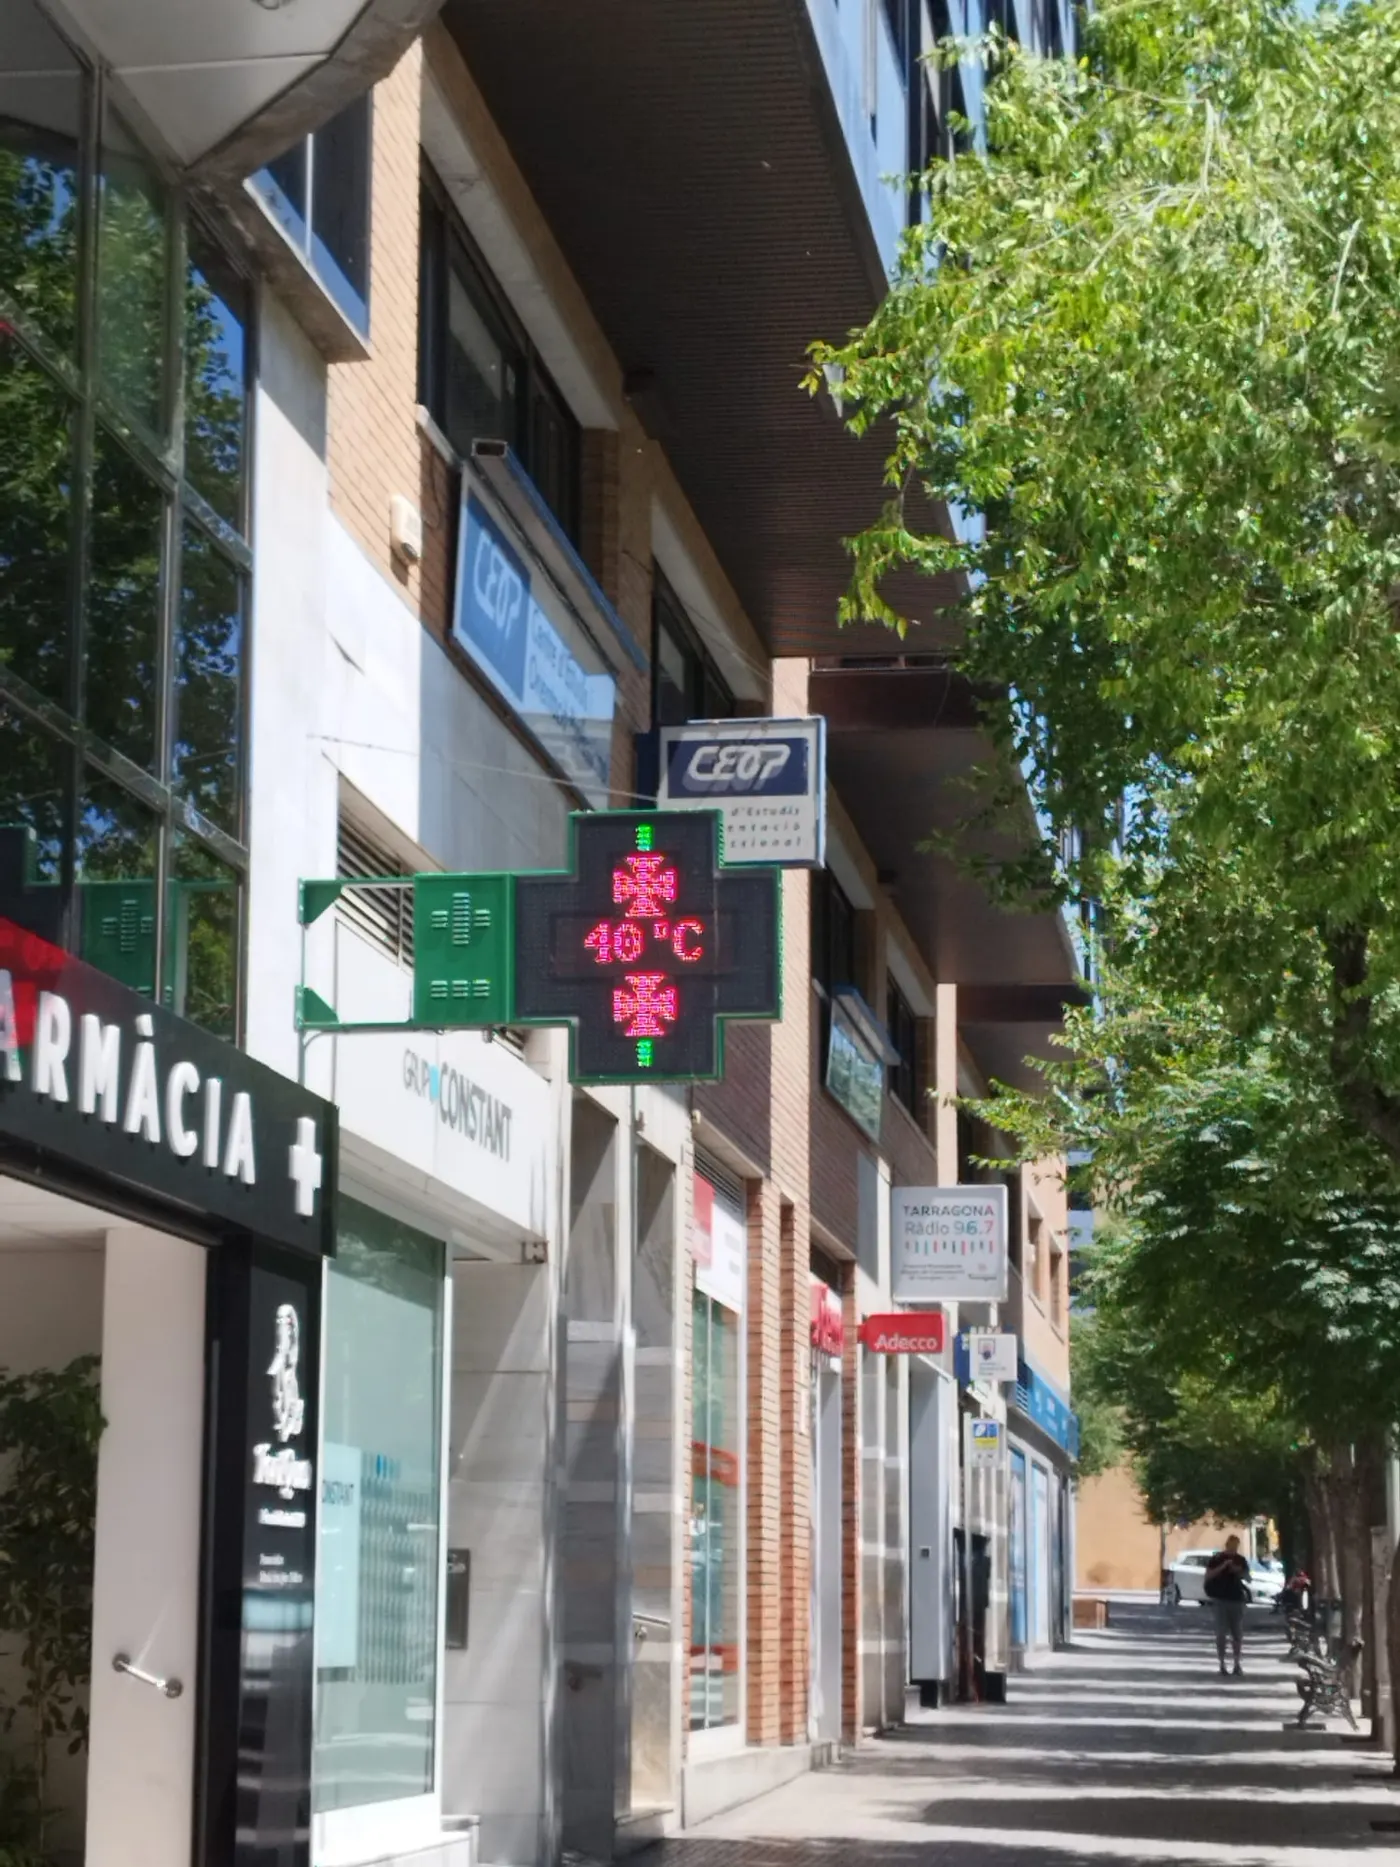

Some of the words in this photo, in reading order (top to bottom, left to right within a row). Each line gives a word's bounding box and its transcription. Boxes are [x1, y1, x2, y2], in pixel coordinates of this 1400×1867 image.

[473, 526, 523, 640] CEOP
[687, 743, 791, 781] CEOP
[440, 1061, 513, 1163] CONSTANT
[903, 1205, 995, 1217] TARRAGONA
[905, 1220, 950, 1236] Ràdio
[953, 1219, 995, 1236] 96.7
[874, 1332, 939, 1351] Adecco
